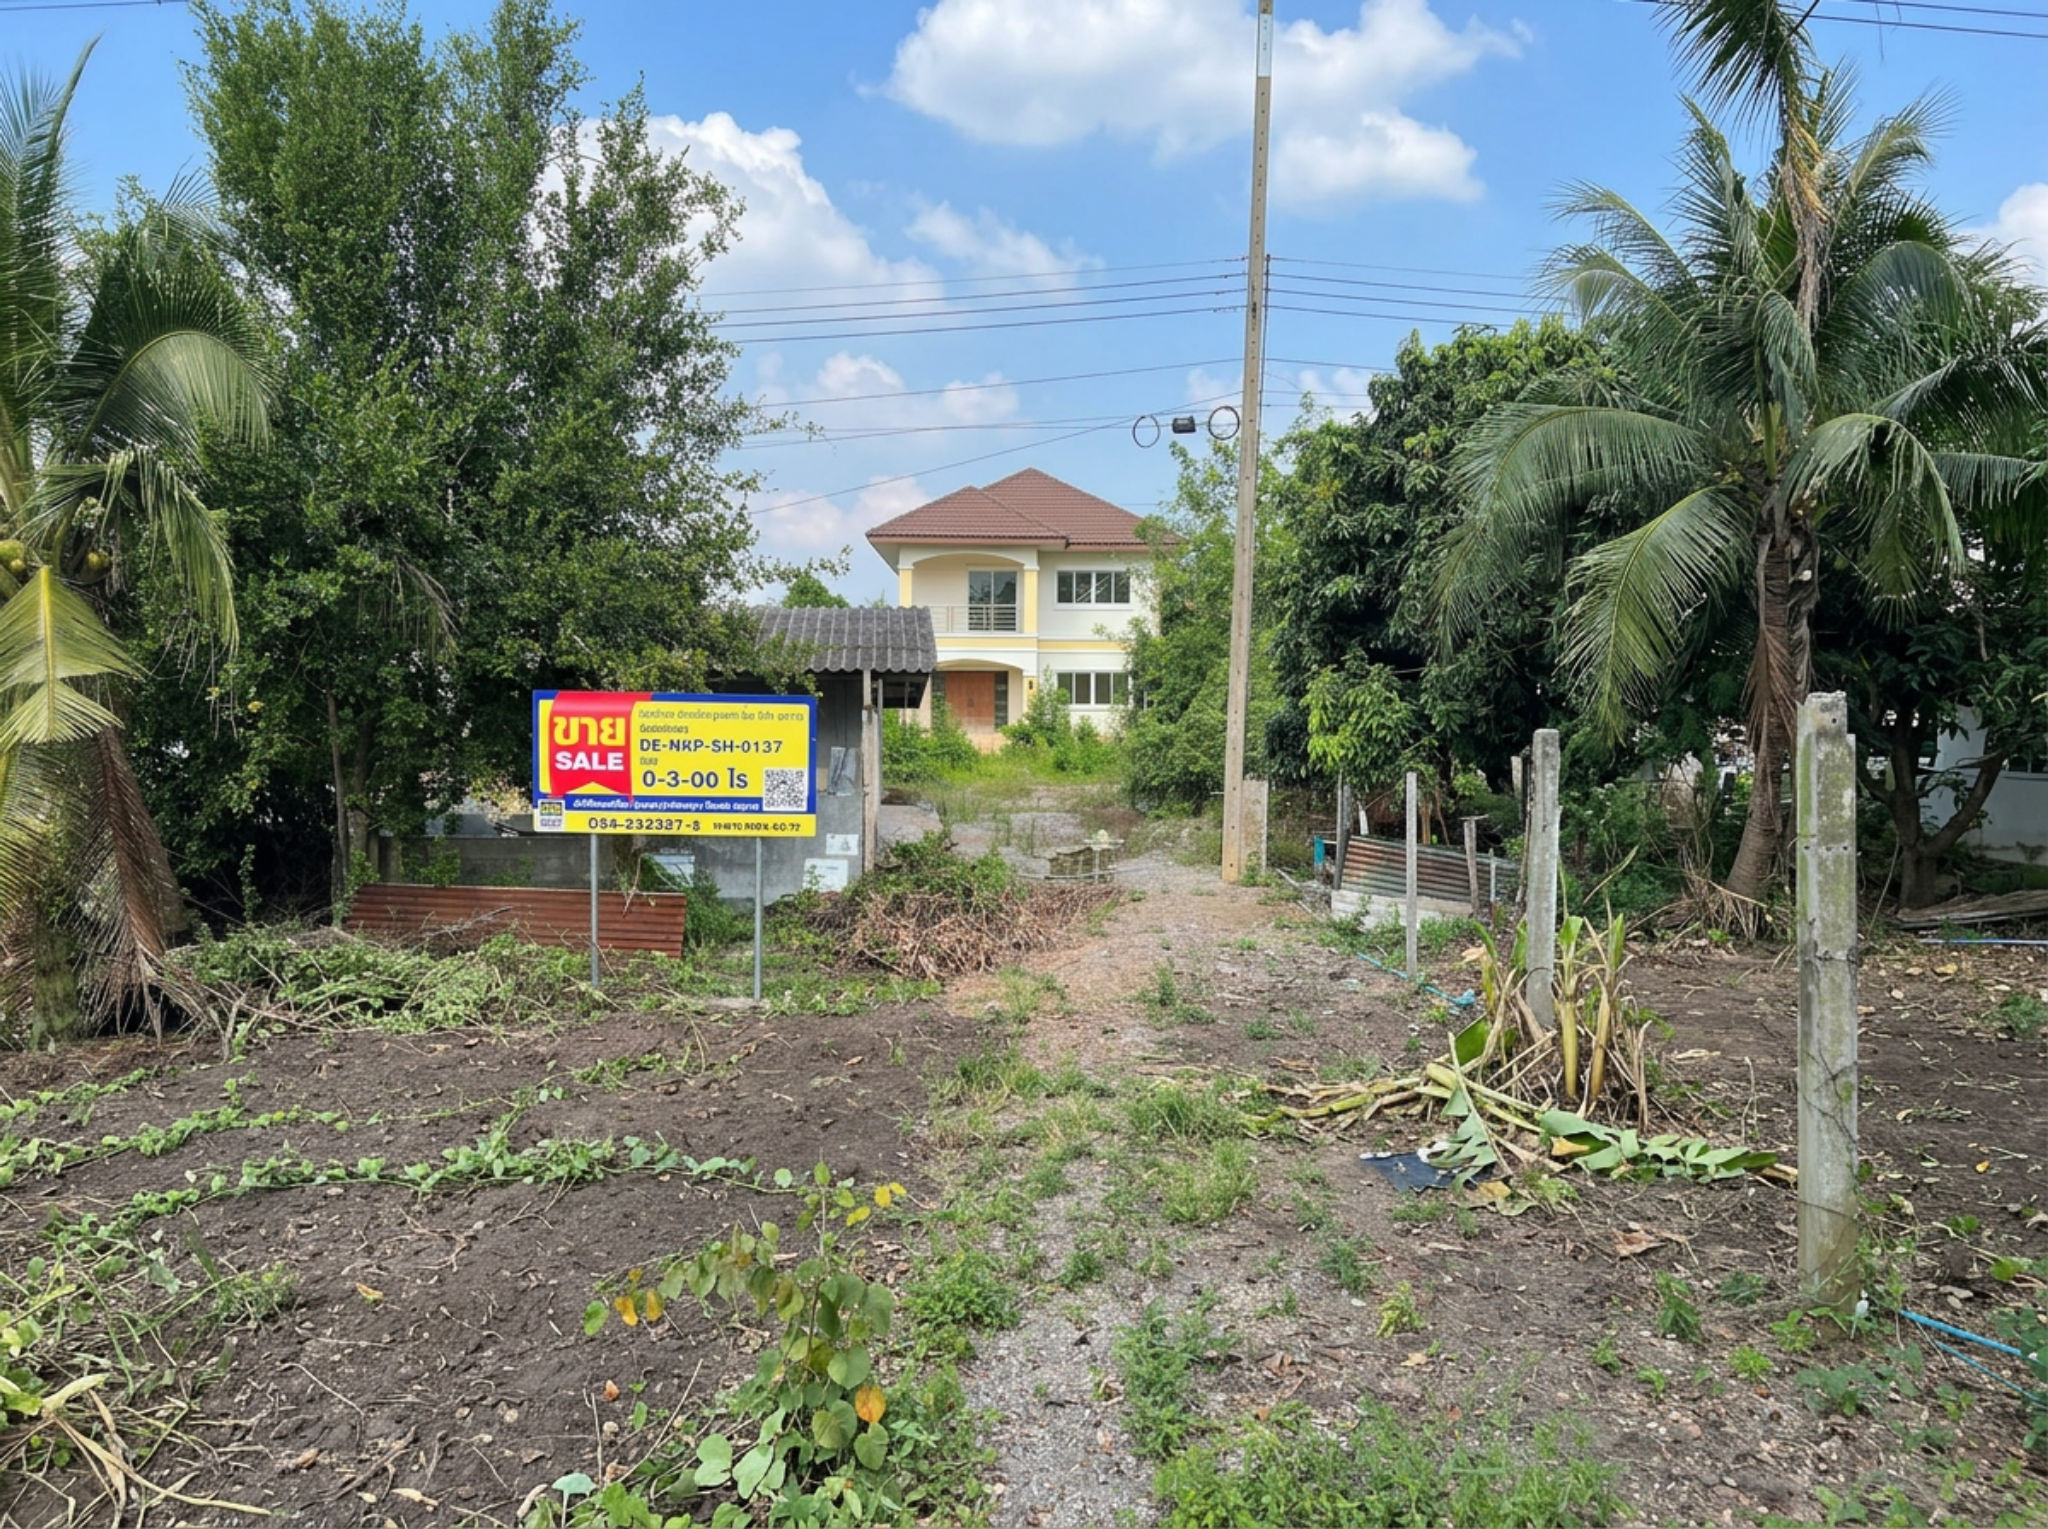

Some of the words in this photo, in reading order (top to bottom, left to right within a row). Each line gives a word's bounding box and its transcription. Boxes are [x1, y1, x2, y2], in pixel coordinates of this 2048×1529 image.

[553, 716, 625, 746] ขาย
[555, 751, 625, 771] SALE
[642, 770, 719, 788] 0-3-00
